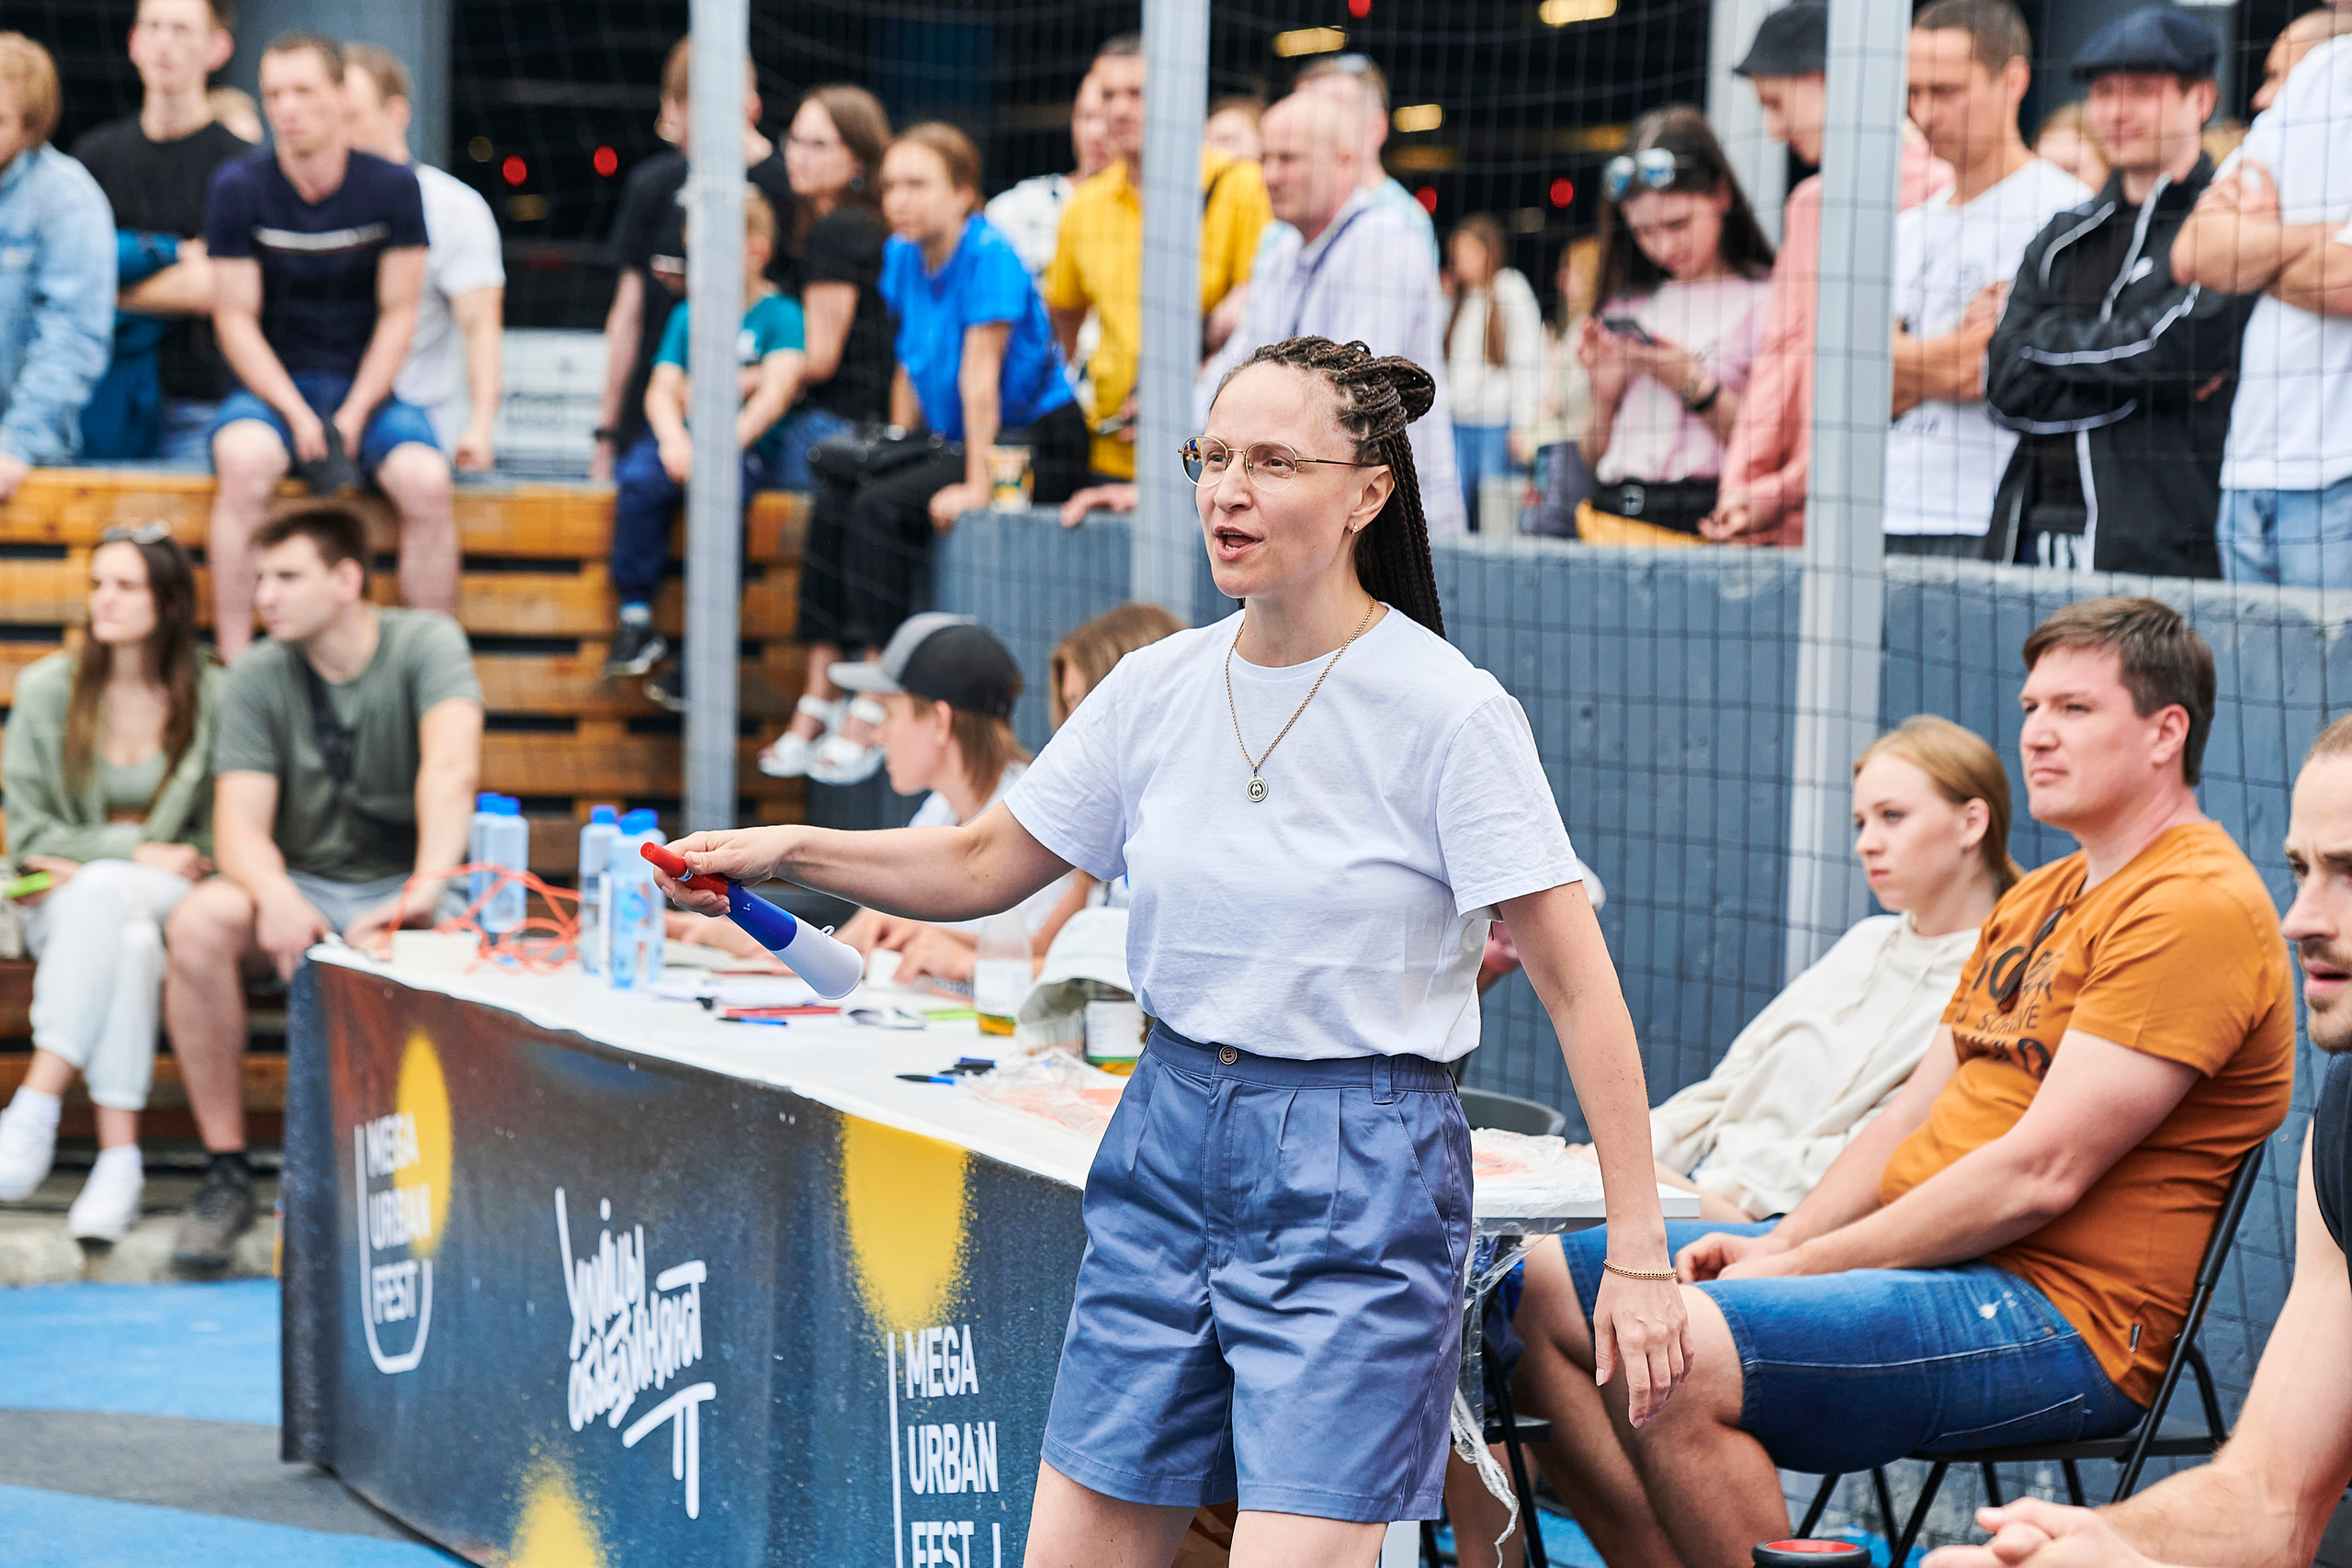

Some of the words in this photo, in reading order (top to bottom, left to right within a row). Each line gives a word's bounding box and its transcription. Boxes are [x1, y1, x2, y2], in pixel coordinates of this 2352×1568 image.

[367, 1112, 421, 1179] MEGA
[368, 1182, 433, 1251] URBAN
[371, 1258, 419, 1325] FEST
[905, 1324, 980, 1400] MEGA
[907, 1421, 1000, 1495] URBAN
[910, 1520, 976, 1568] FEST
